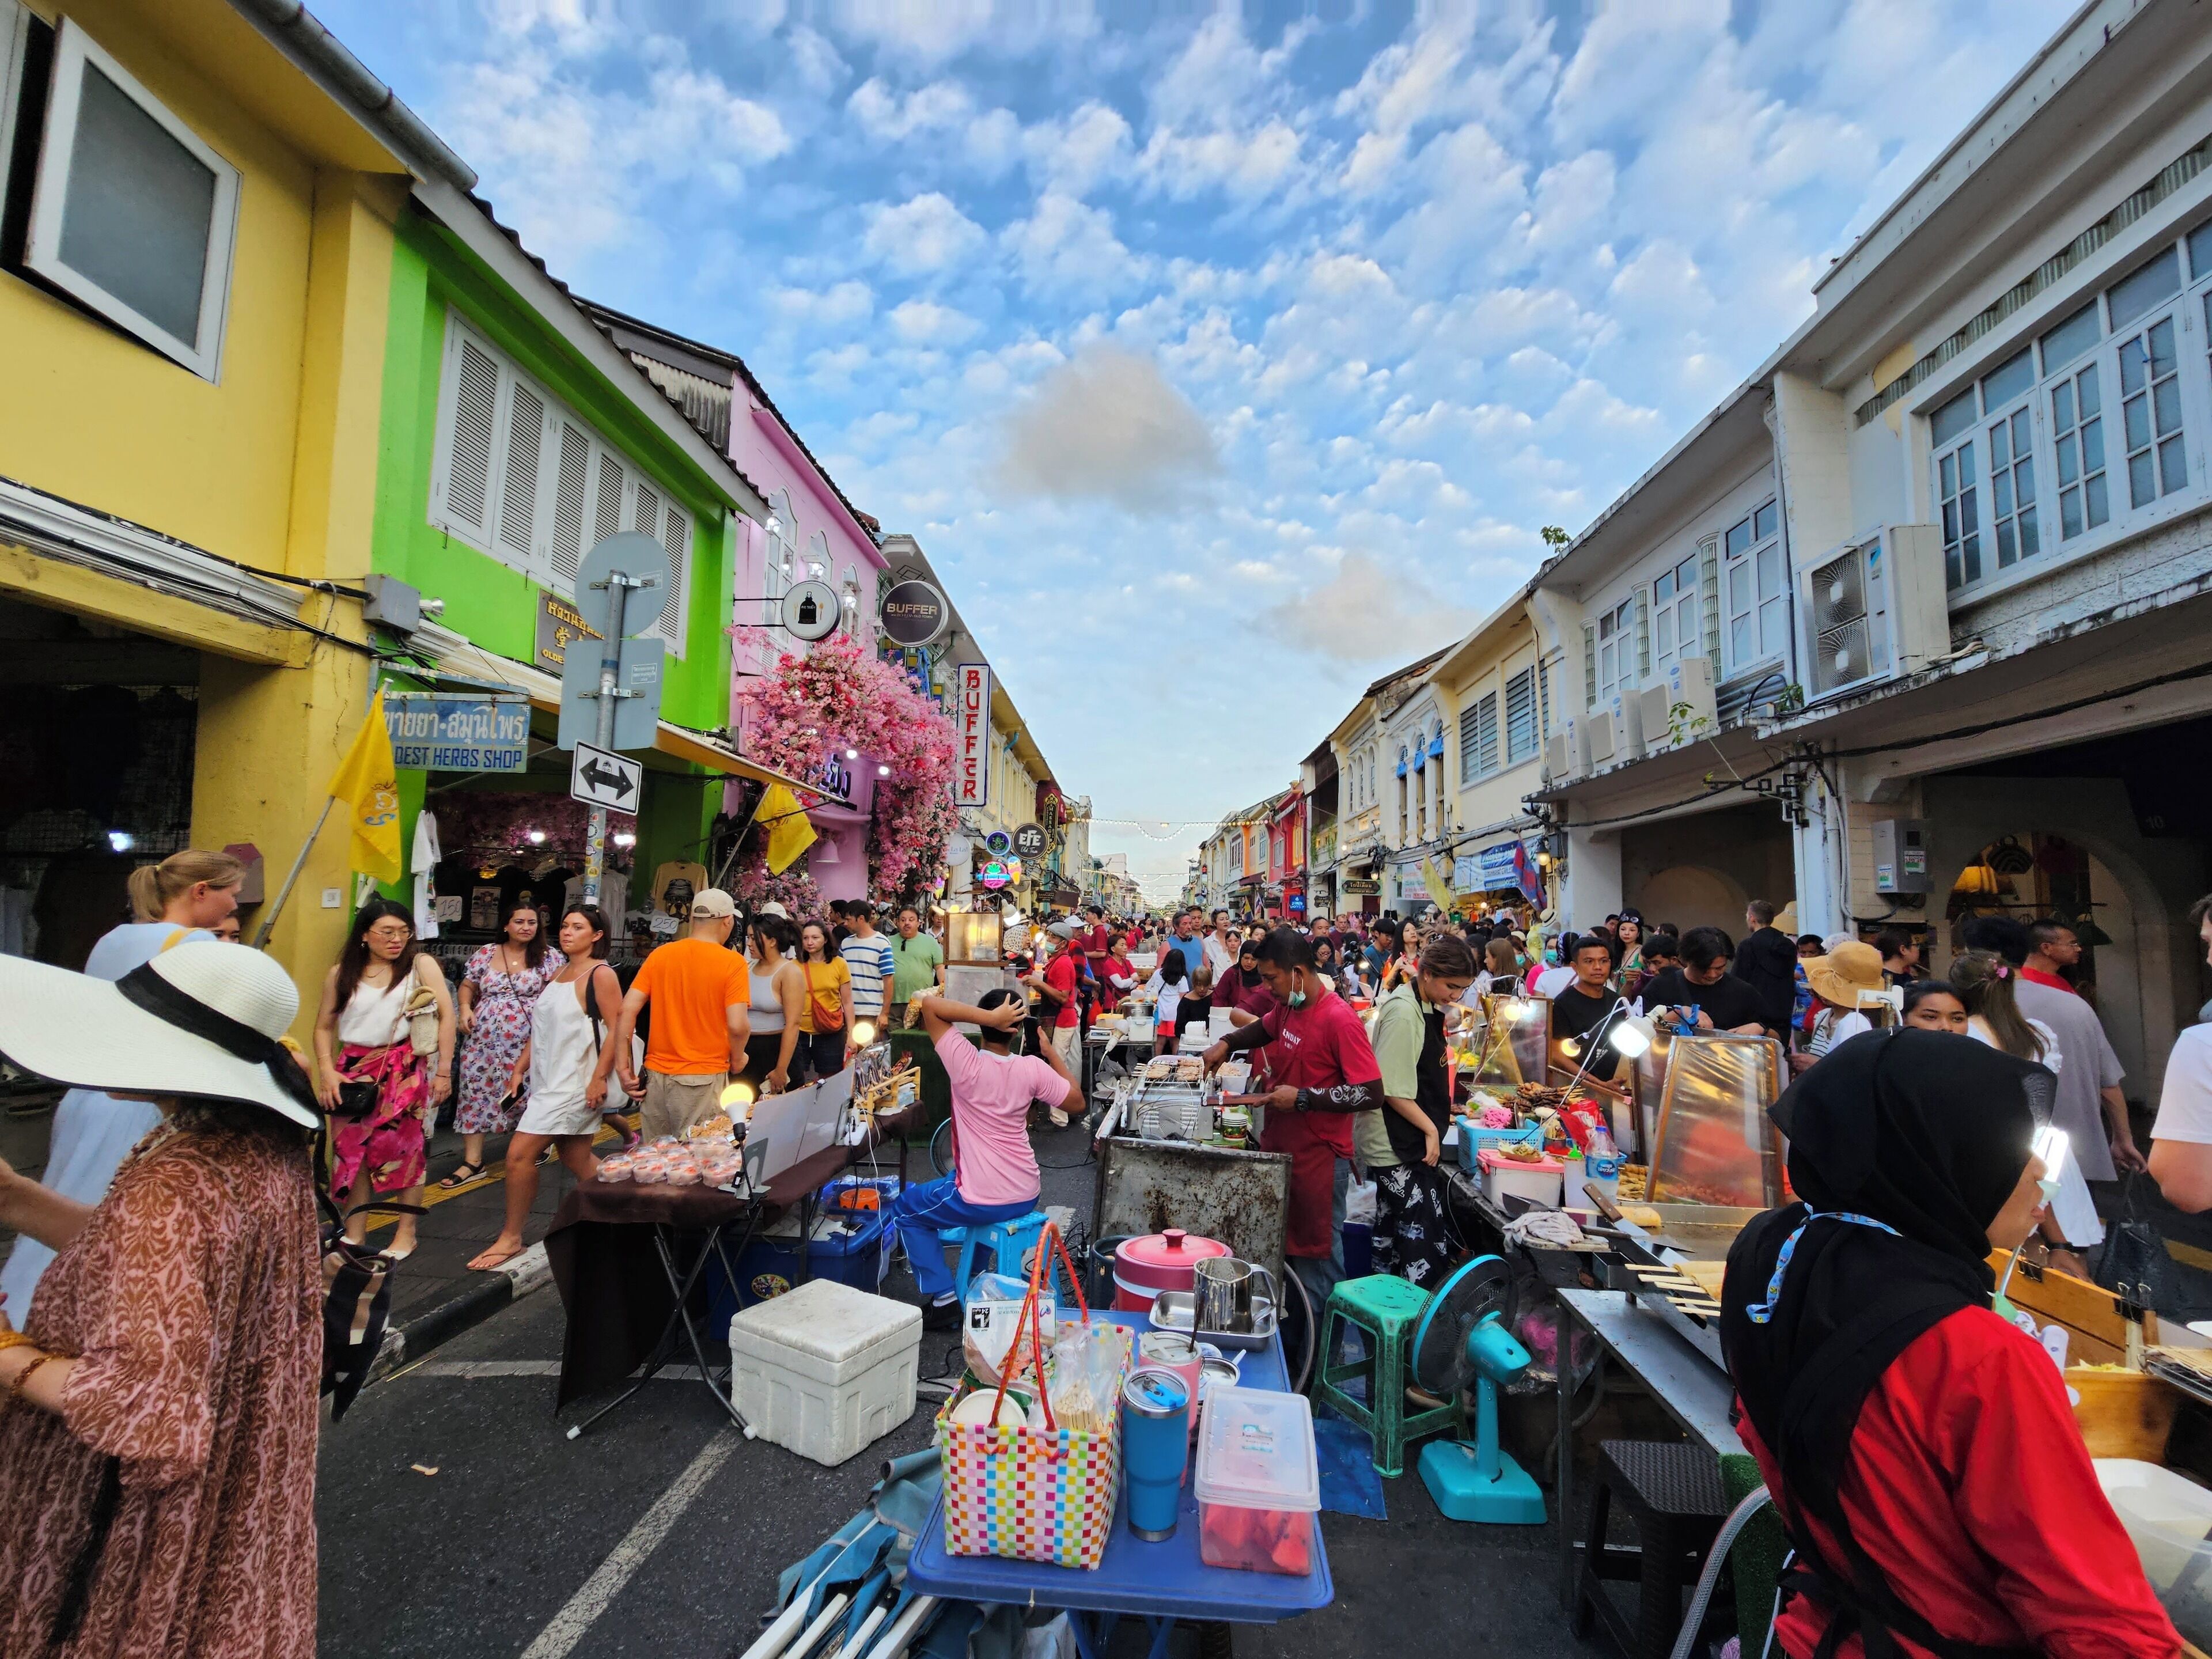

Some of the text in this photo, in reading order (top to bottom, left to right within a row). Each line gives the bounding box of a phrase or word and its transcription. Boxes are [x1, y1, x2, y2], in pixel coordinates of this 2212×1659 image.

[887, 603, 938, 615] BUFFER
[963, 669, 980, 800] BUFFER
[433, 747, 479, 768] HERBS
[483, 750, 522, 768] SHOP
[1018, 830, 1041, 846] EFE
[440, 899, 461, 917] 150
[652, 917, 677, 930] 250
